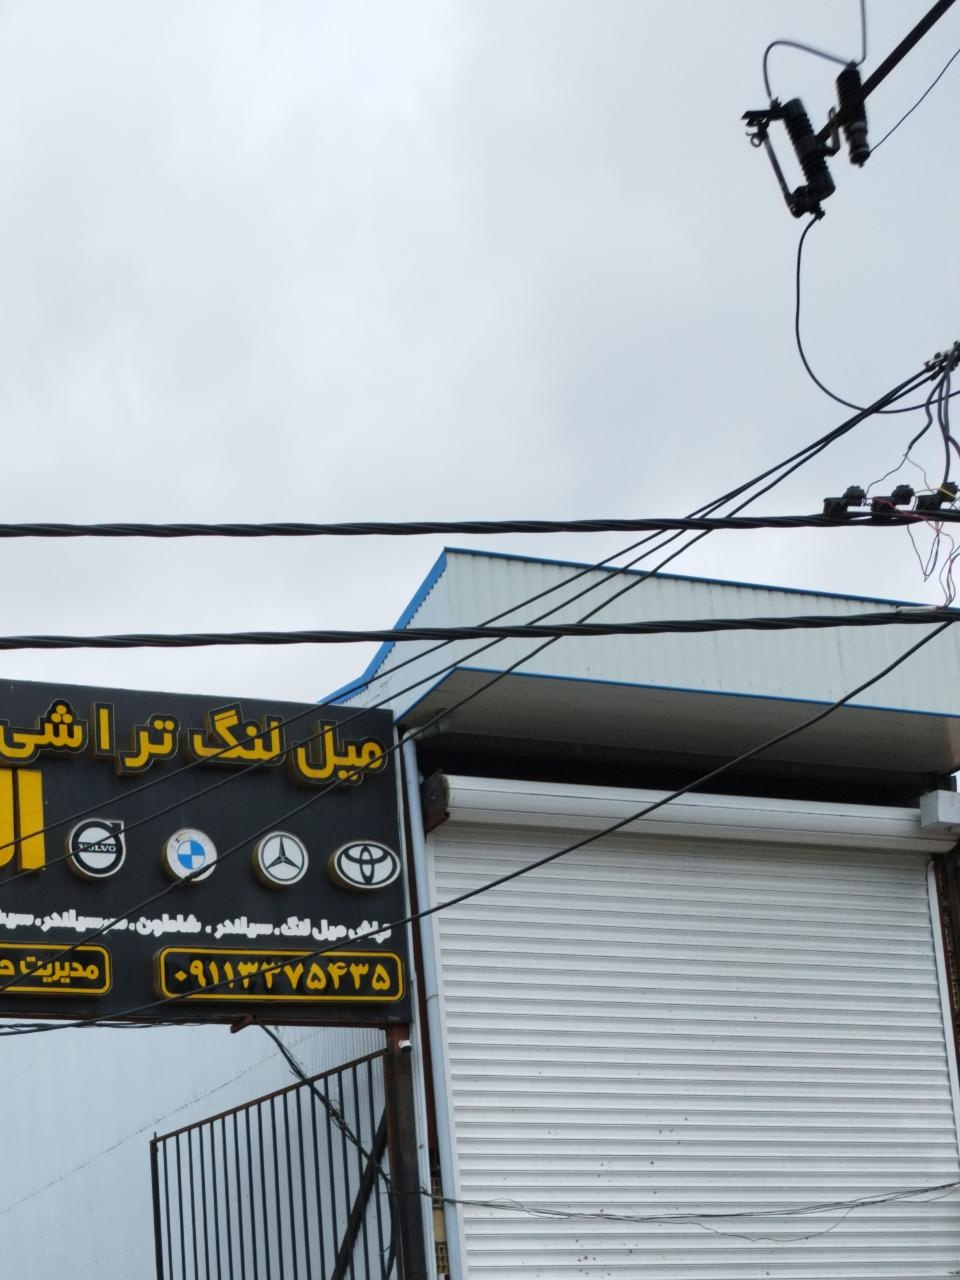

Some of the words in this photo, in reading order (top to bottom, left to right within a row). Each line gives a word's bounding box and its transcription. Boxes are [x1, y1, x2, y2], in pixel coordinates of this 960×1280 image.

[192, 708, 281, 759] لنگ
[295, 724, 385, 781] میل
[19, 955, 100, 984] مدیریت
